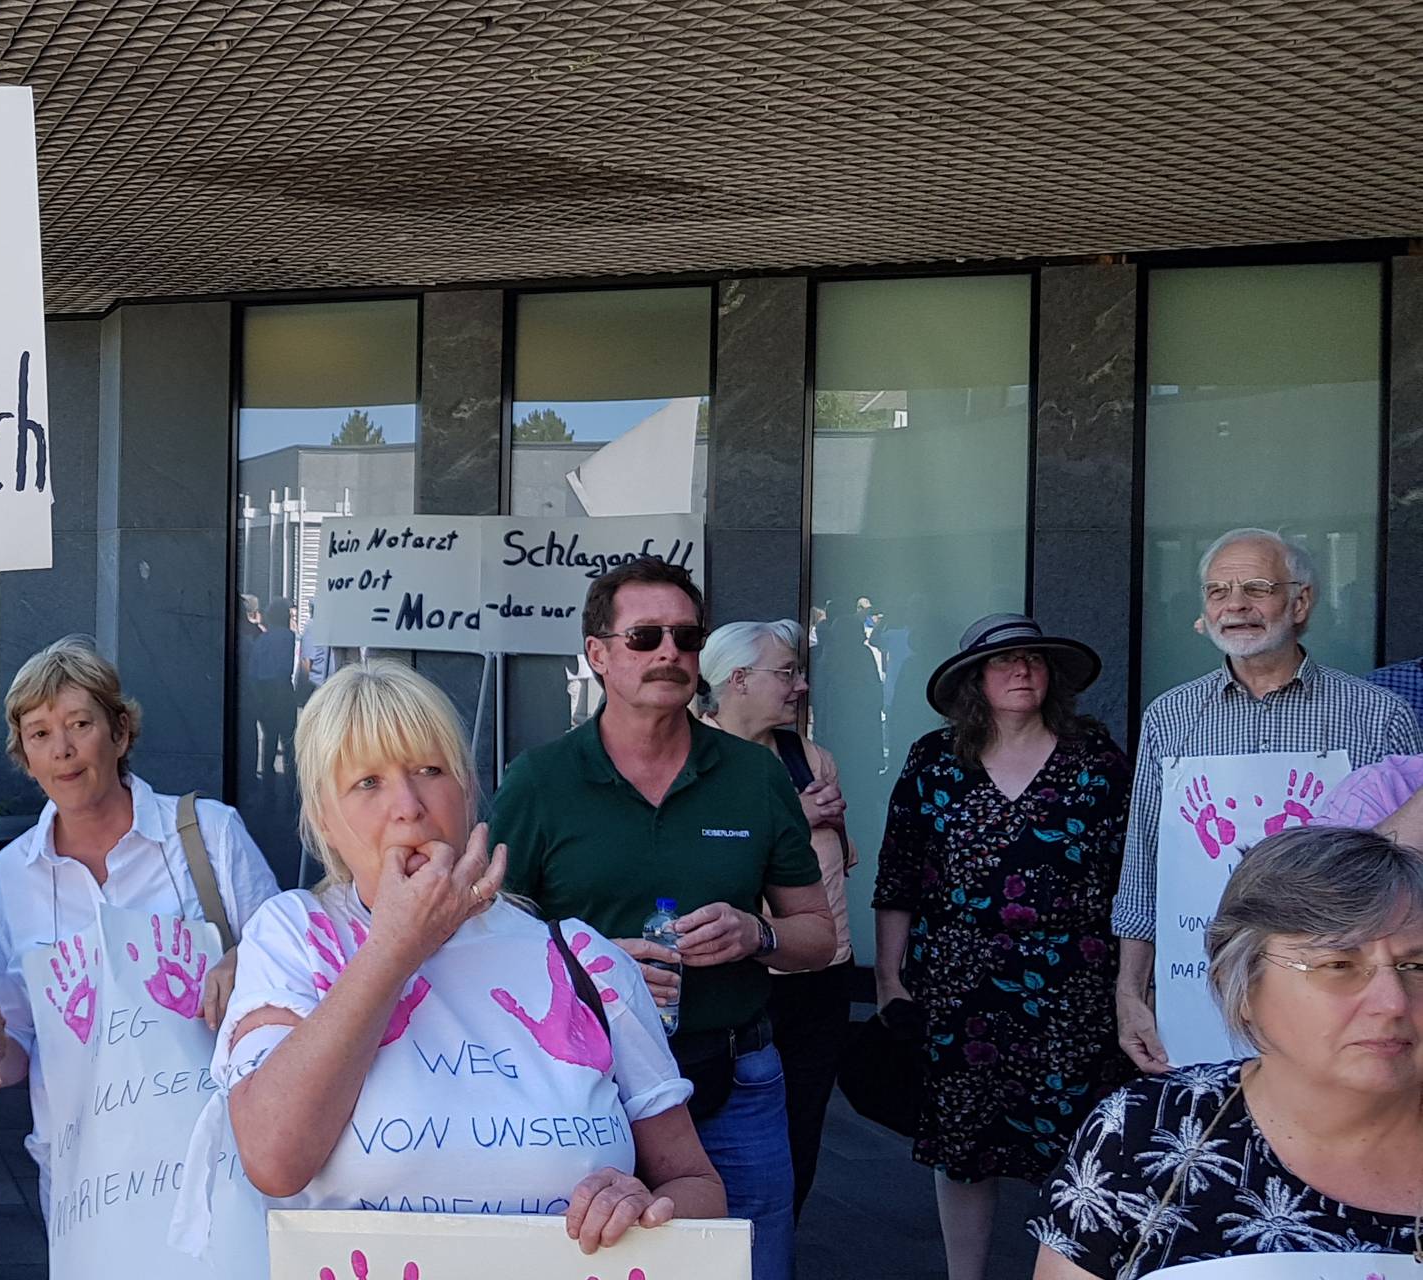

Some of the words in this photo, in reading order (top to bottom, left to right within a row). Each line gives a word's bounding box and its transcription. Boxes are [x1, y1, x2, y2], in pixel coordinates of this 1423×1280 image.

[328, 529, 360, 558] kein
[366, 527, 459, 552] Notarzt
[327, 575, 354, 592] vor
[358, 569, 392, 591] Ort
[541, 604, 576, 619] war
[413, 1040, 519, 1079] WEG
[352, 1116, 450, 1155] VON
[472, 1116, 627, 1149] UNSEREM
